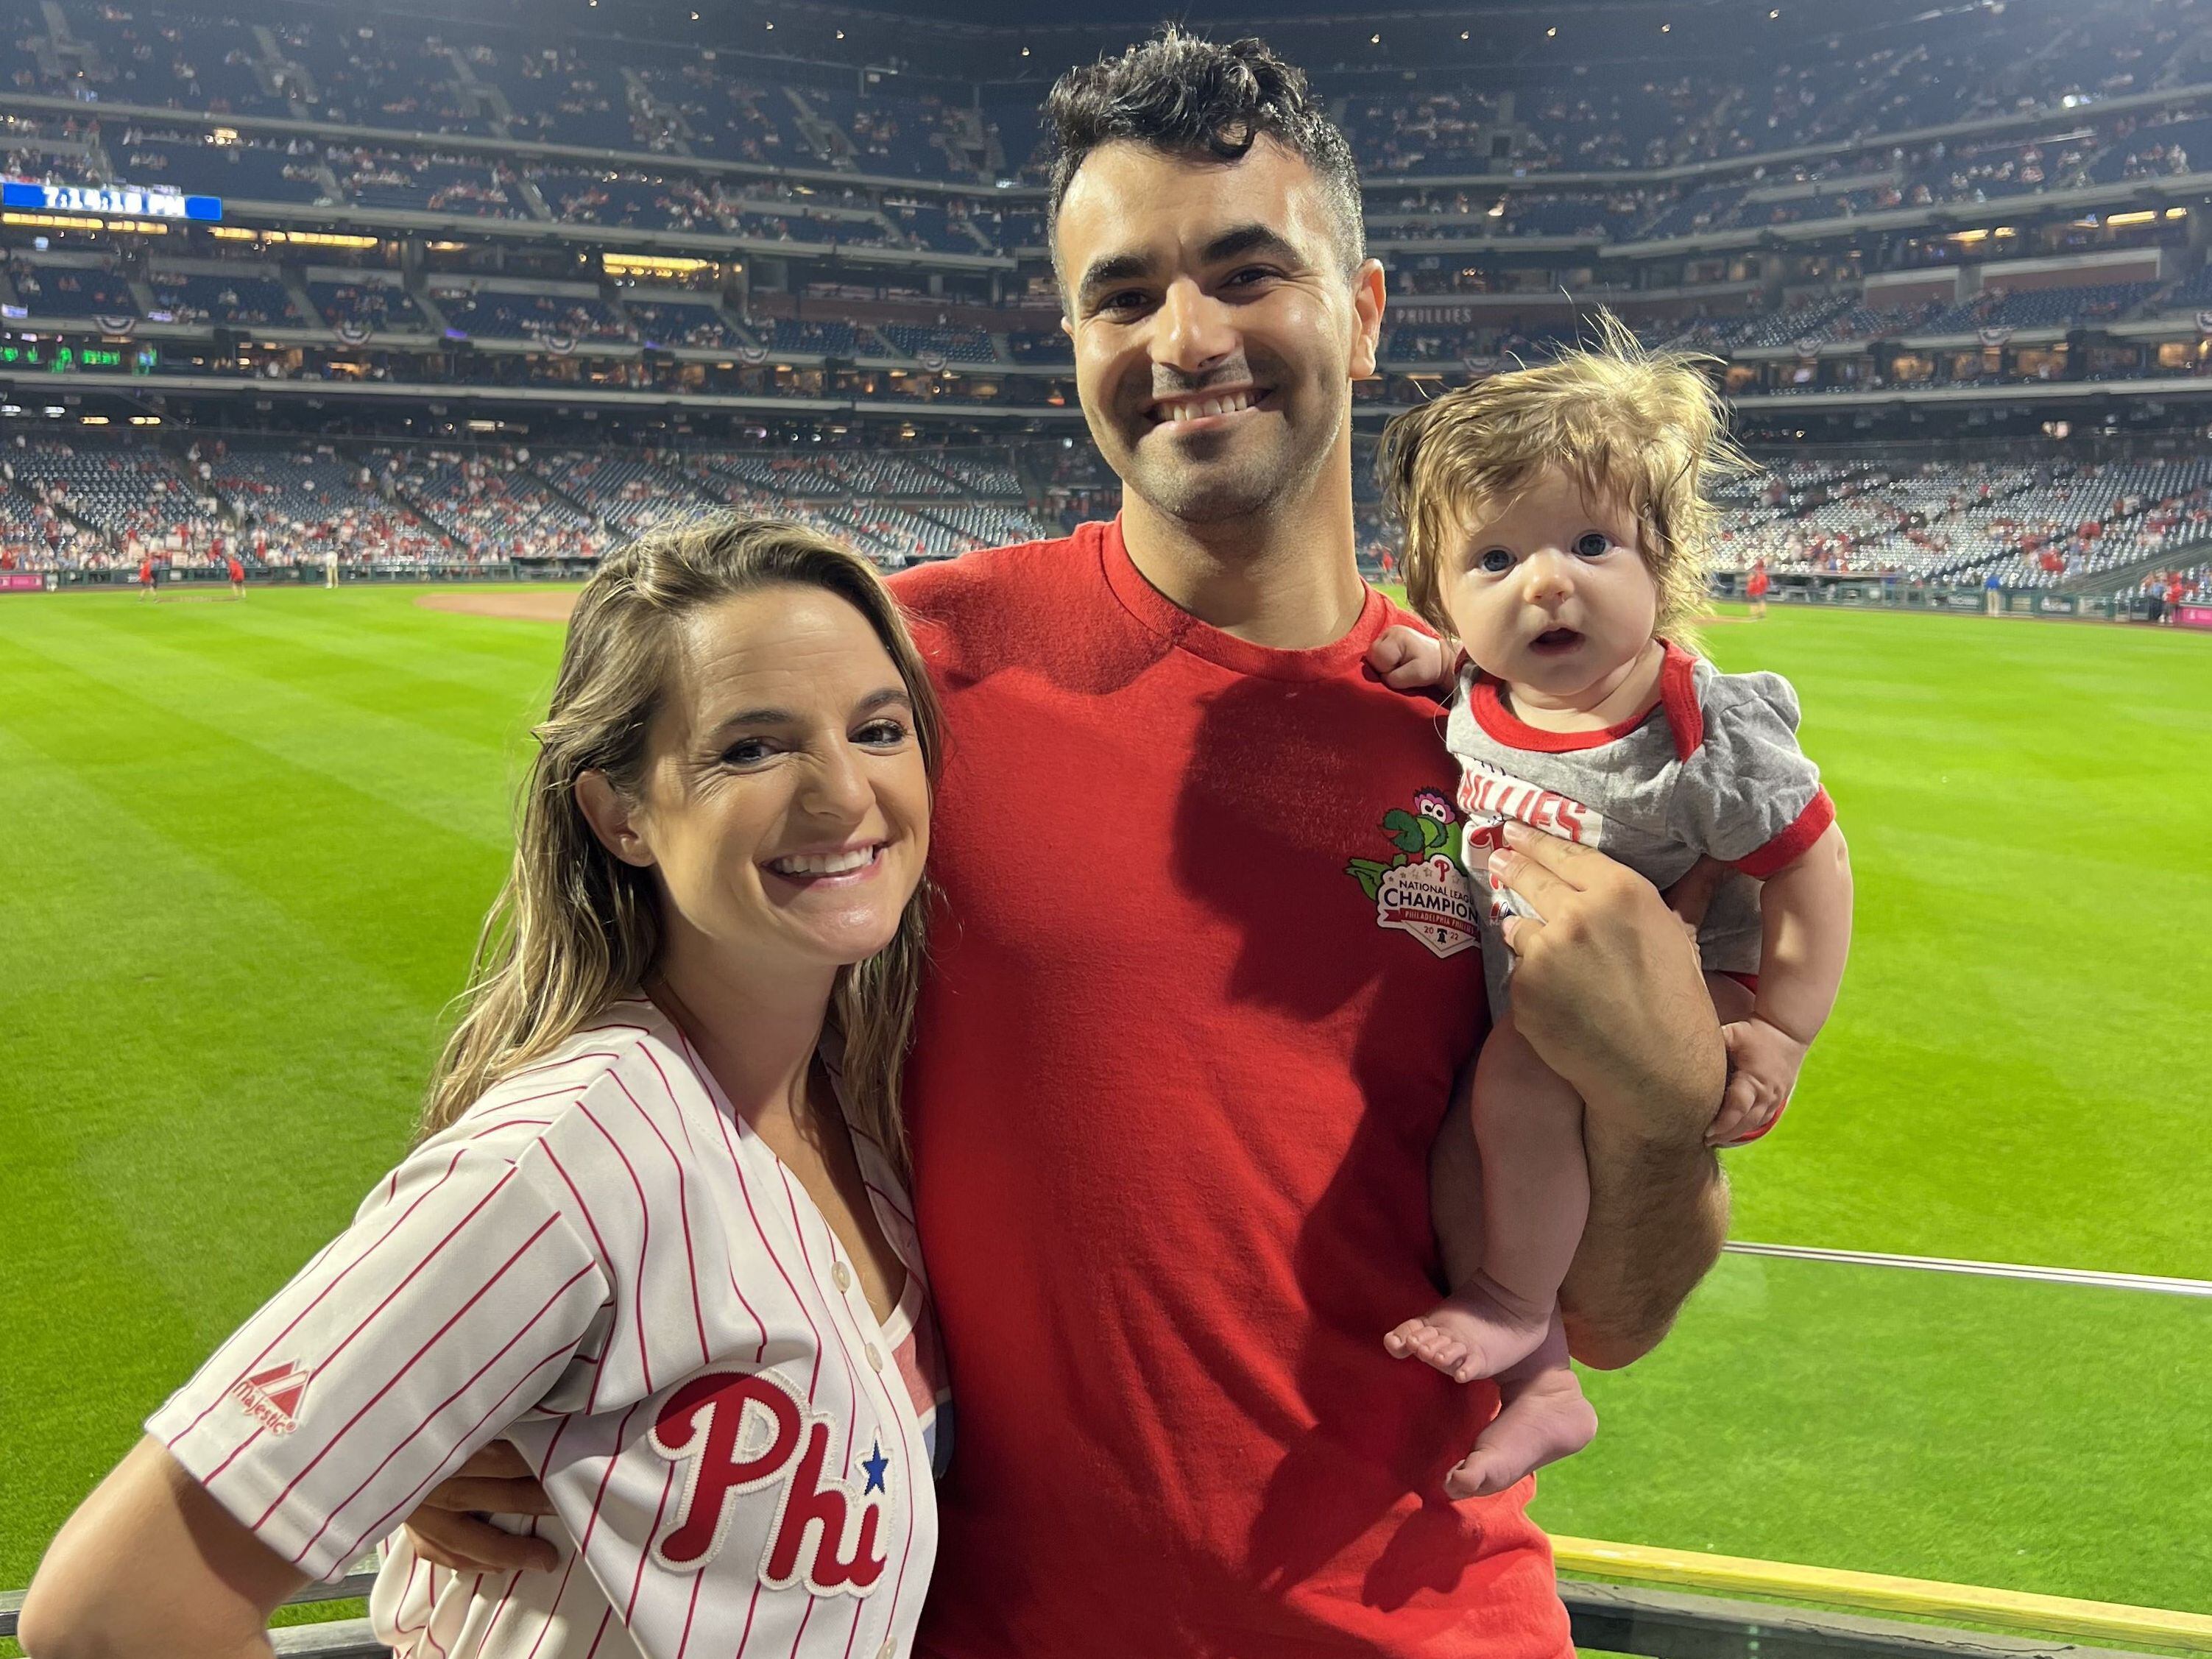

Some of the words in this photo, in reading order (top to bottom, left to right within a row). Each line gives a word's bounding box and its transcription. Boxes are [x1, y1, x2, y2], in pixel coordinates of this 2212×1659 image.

[149, 194, 185, 216] PM
[1395, 308, 1471, 325] PHILLIES
[1434, 859, 1451, 882] P
[1399, 880, 1448, 896] NATIONAL
[1450, 890, 1474, 905] LEAGU
[1384, 888, 1479, 924] CHAMPION
[1404, 910, 1450, 925] PHILADELPHIA
[1424, 925, 1434, 934] 20
[1450, 931, 1459, 940] 22
[654, 1370, 888, 1587] Phi
